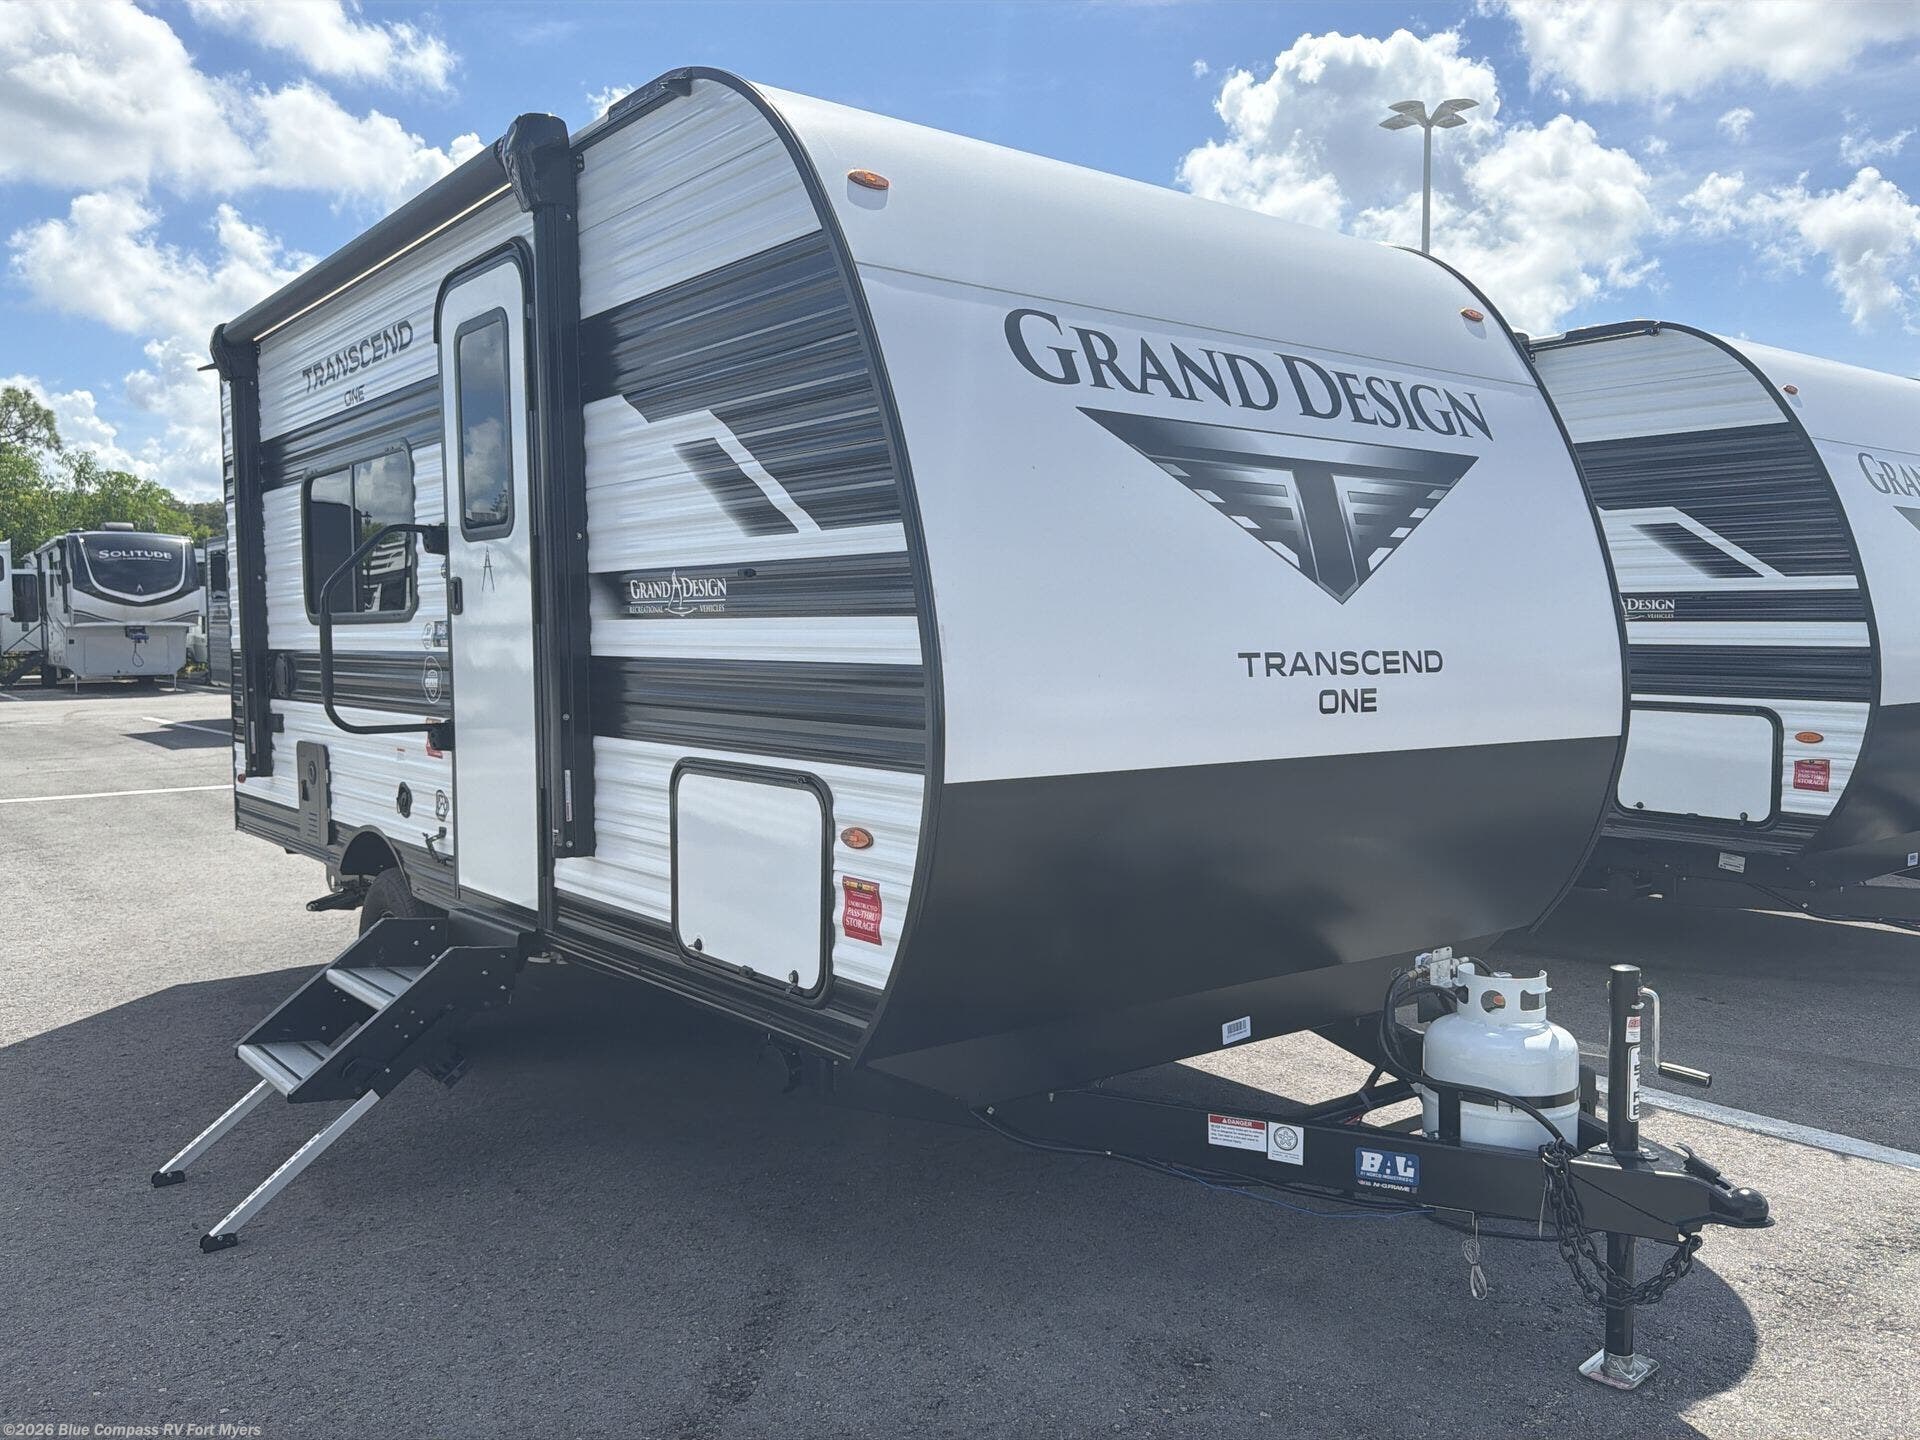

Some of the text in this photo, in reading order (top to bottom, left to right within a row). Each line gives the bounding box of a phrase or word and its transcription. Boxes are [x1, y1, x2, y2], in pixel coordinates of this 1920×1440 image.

[302, 320, 414, 393] TRANSCEND
[1004, 307, 1494, 442] GRAND DESIGN
[344, 384, 366, 407] ONE
[98, 549, 173, 560] SOLITUDE
[630, 577, 727, 599] GRAND DESIGN
[629, 604, 725, 614] RECREATIONAL VEHICLES
[1626, 598, 1675, 610] DESIGN
[1237, 649, 1444, 678] TRANSCEND
[1319, 688, 1378, 715] ONE
[845, 918, 876, 931] STORAGE
[847, 907, 877, 921] PASS-THRU
[1227, 1118, 1253, 1127] DANGER
[1360, 1151, 1415, 1178] BAL
